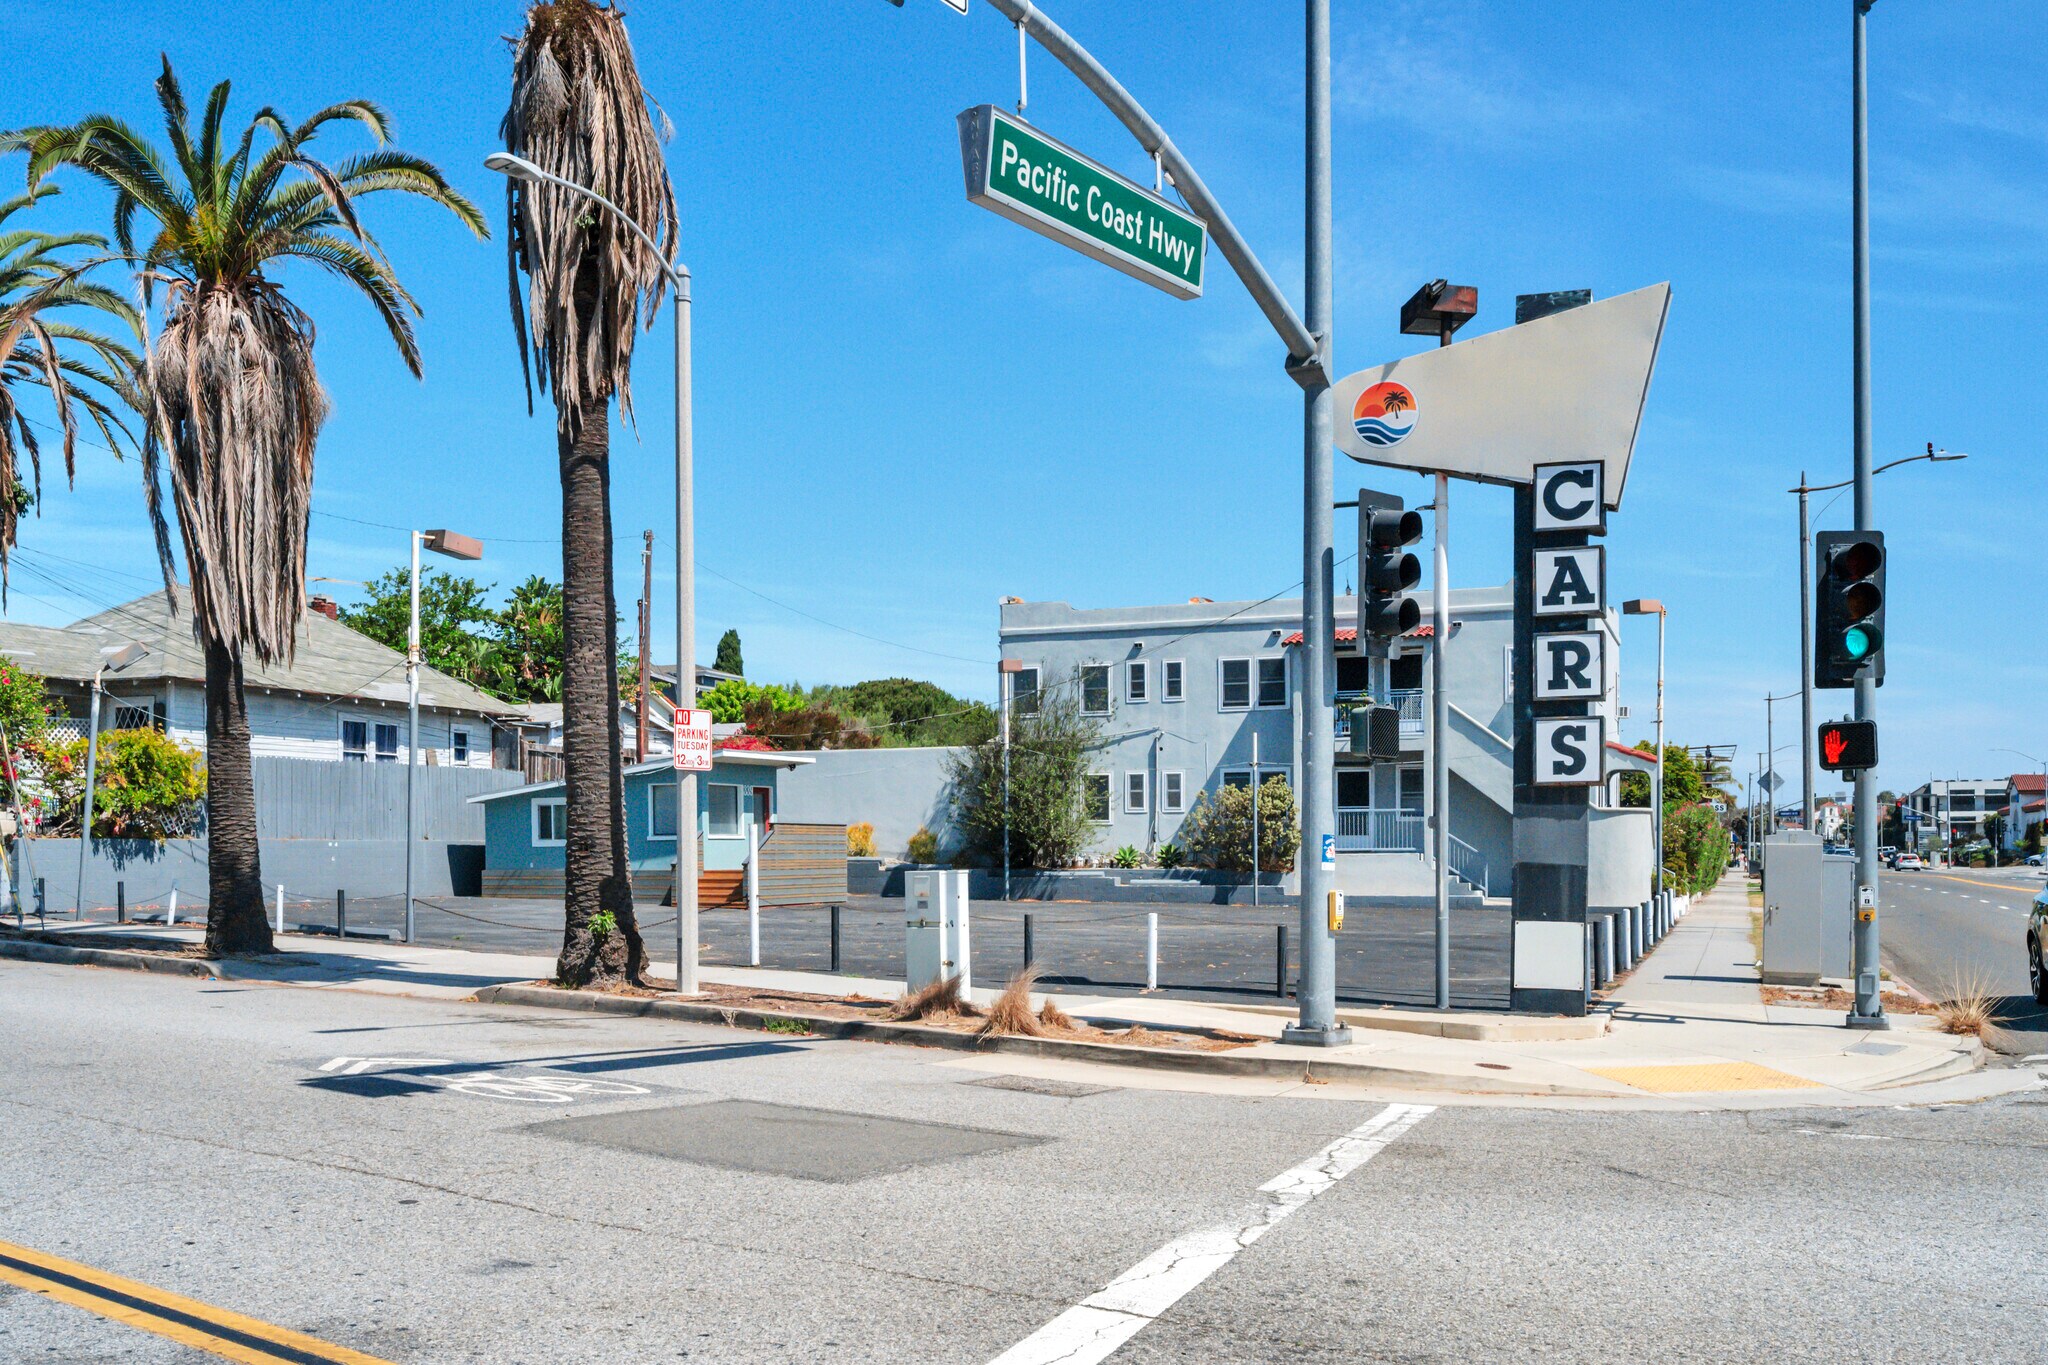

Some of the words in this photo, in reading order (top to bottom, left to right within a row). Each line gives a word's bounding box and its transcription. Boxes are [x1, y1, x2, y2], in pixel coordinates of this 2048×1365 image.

[1000, 139, 1080, 212] Pacific
[1086, 185, 1143, 245] Coast
[1148, 216, 1195, 276] Hwy
[1542, 469, 1595, 777] CARS
[677, 710, 689, 724] NO
[677, 727, 709, 741] PARKING
[677, 740, 709, 751] TUESDAY
